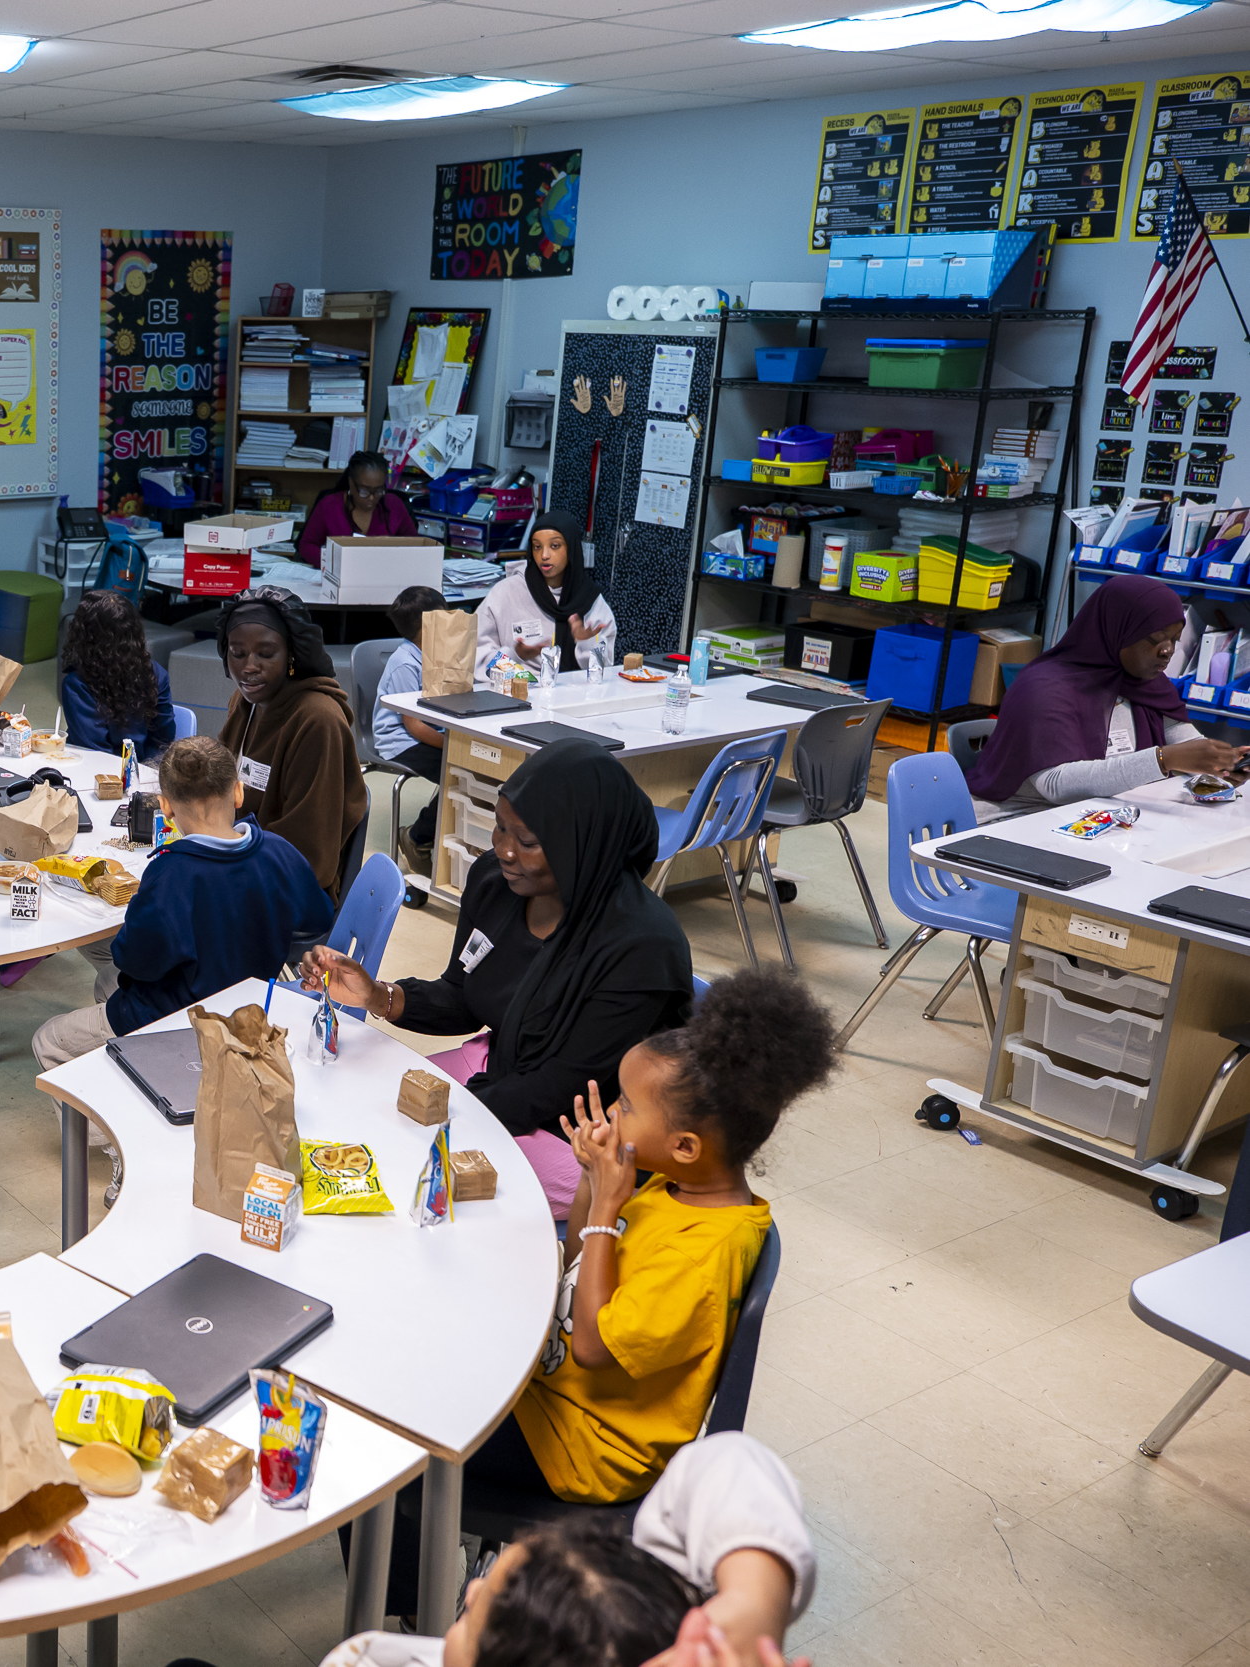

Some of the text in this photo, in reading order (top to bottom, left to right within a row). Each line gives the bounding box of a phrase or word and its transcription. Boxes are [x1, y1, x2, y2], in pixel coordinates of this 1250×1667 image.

[1161, 80, 1211, 92] CLASSROOM
[1035, 94, 1080, 105] TECHNOLOGY
[1191, 92, 1200, 100] WE
[925, 103, 983, 116] HAND SIGNALS
[827, 118, 855, 128] RECESS
[442, 158, 524, 195] THE FUTURE
[457, 193, 523, 219] WORLD
[455, 220, 520, 248] ROOM
[0, 264, 36, 273] COOL KIDS
[437, 248, 520, 278] TODAY
[148, 299, 179, 325] BE
[142, 332, 185, 358] THE
[113, 363, 212, 392] REASON
[131, 399, 193, 417] SOMEONE
[1111, 410, 1127, 418] Door
[1105, 417, 1130, 425] HOLDER
[1162, 412, 1176, 420] Line
[1153, 420, 1180, 429] LEADER
[1199, 418, 1225, 427] Pencils
[113, 426, 208, 459] SMILES
[753, 465, 770, 474] YELLOW
[1190, 473, 1214, 482] HELPER
[760, 521, 782, 535] Mail
[857, 565, 887, 574] DIVERSITY
[1216, 566, 1222, 576] 4
[858, 572, 887, 581] INCLUSION
[13, 886, 37, 895] MILK
[12, 908, 37, 917] FACT
[248, 1195, 281, 1211] LOCAL
[247, 1203, 280, 1220] FRESH
[245, 1212, 280, 1228] FAT FREE
[245, 1219, 279, 1233] CHOCOLATE
[244, 1223, 278, 1242] MILK
